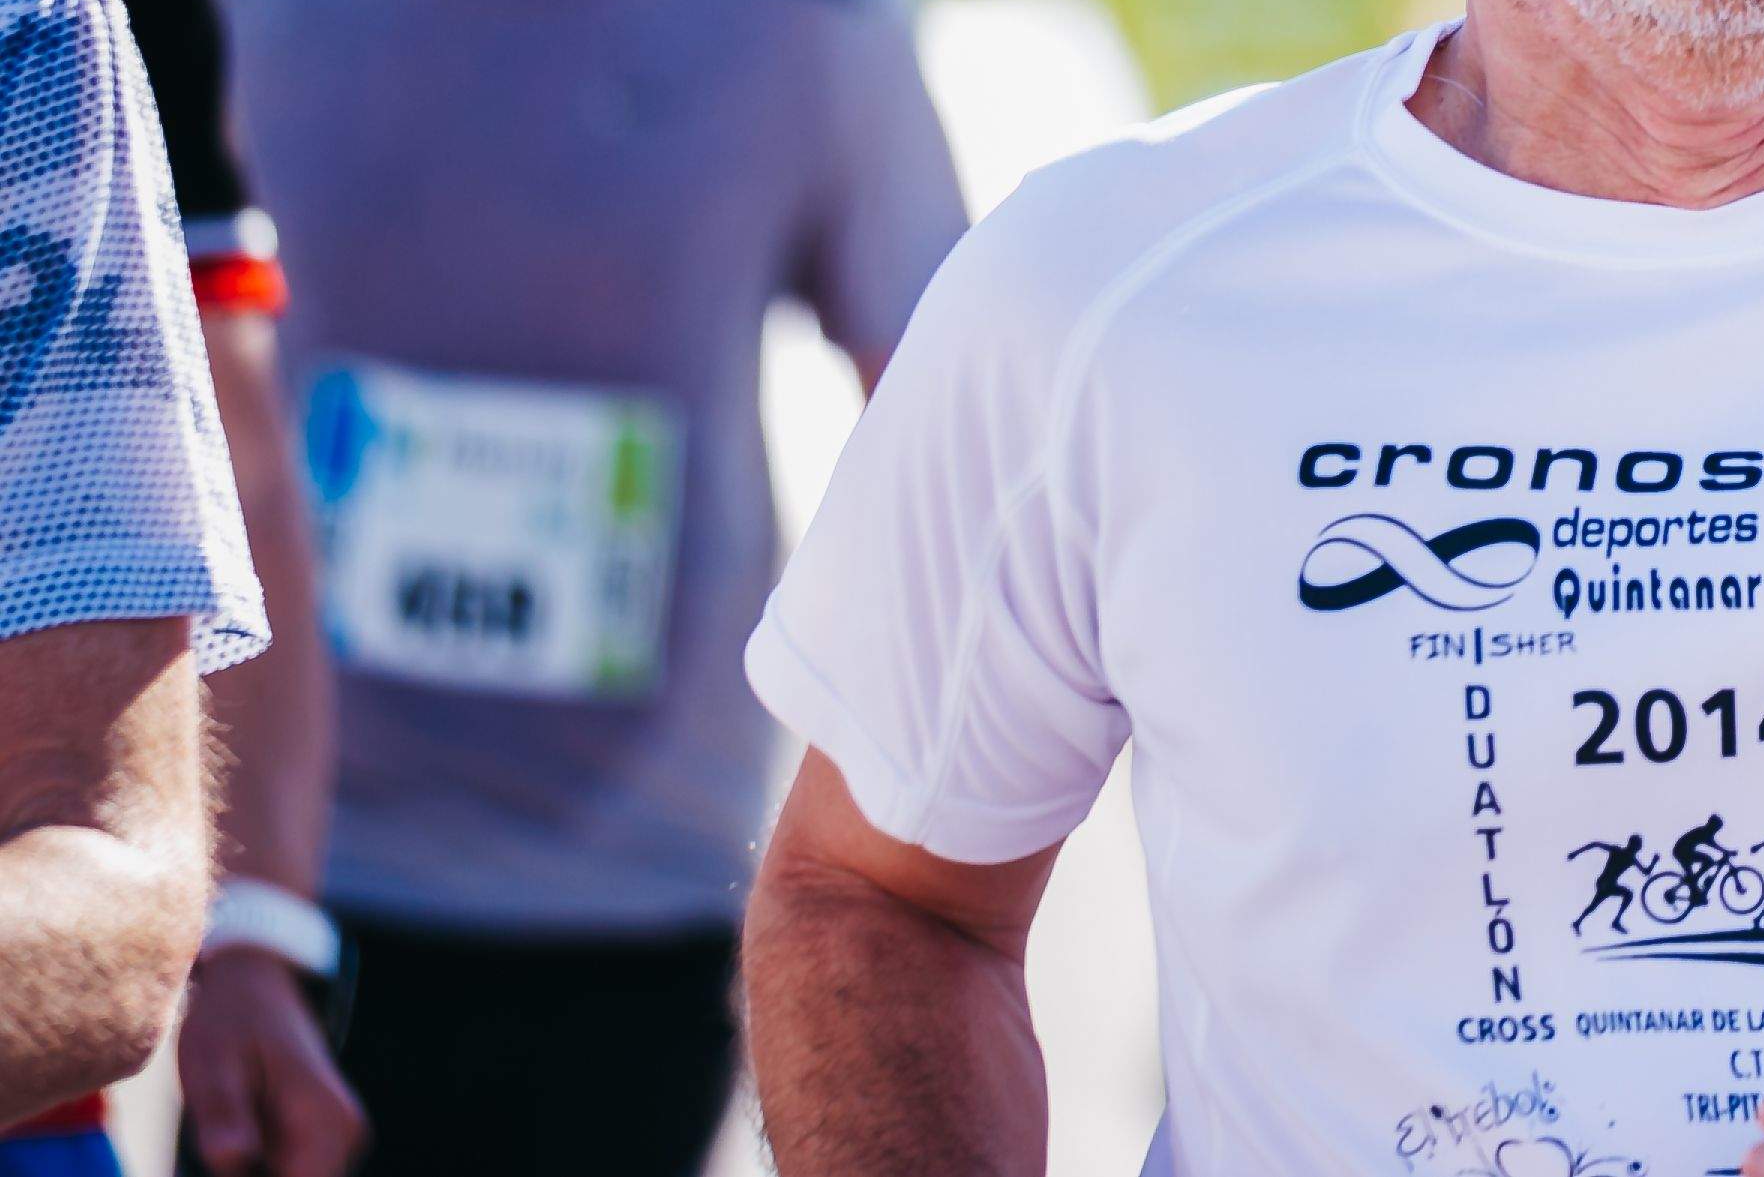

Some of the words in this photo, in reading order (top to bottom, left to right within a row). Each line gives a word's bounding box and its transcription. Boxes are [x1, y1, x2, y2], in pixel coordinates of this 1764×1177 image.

[1298, 441, 1764, 494] cronos
[1552, 506, 1759, 559] deportes
[1553, 562, 1763, 620] Quintanar
[1457, 1014, 1556, 1044] CROSS
[1575, 1008, 1705, 1038] QUINTANAR
[1711, 1008, 1741, 1033] DE
